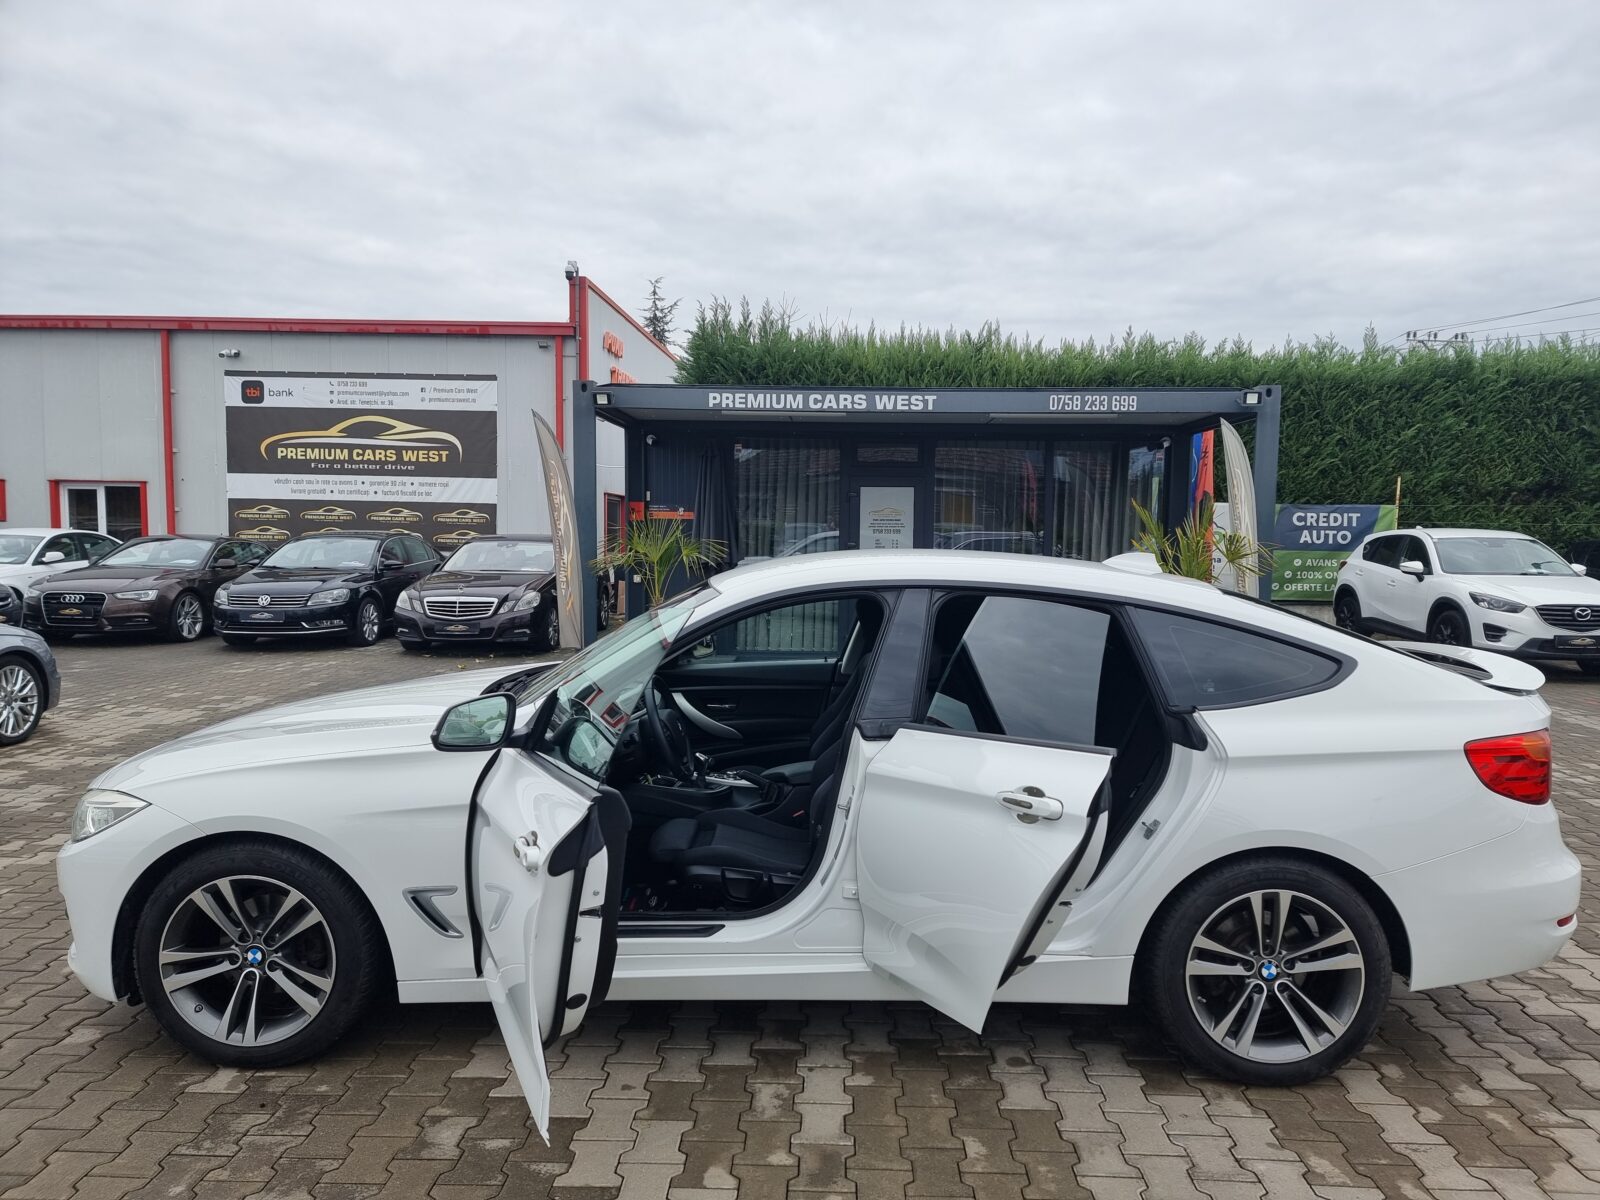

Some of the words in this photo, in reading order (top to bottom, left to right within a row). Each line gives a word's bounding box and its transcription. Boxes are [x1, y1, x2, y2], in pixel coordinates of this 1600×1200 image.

[246, 387, 261, 397] tbi
[268, 388, 294, 397] bank
[708, 392, 804, 409] PREMIUM
[808, 393, 867, 410] CARS
[875, 394, 937, 411] WEST
[1049, 394, 1081, 411] 0758
[1084, 394, 1108, 411] 233
[1111, 395, 1138, 411] 699
[277, 447, 349, 460] PREMIUM
[352, 448, 397, 461] CARS
[402, 449, 449, 463] WEST
[344, 462, 382, 470] better
[384, 463, 415, 471] drive
[1292, 512, 1361, 527] CREDIT
[1299, 529, 1352, 545] AUTO
[1305, 558, 1338, 567] AVANS
[1295, 570, 1323, 579] 100%
[1283, 583, 1322, 592] OFERTE
